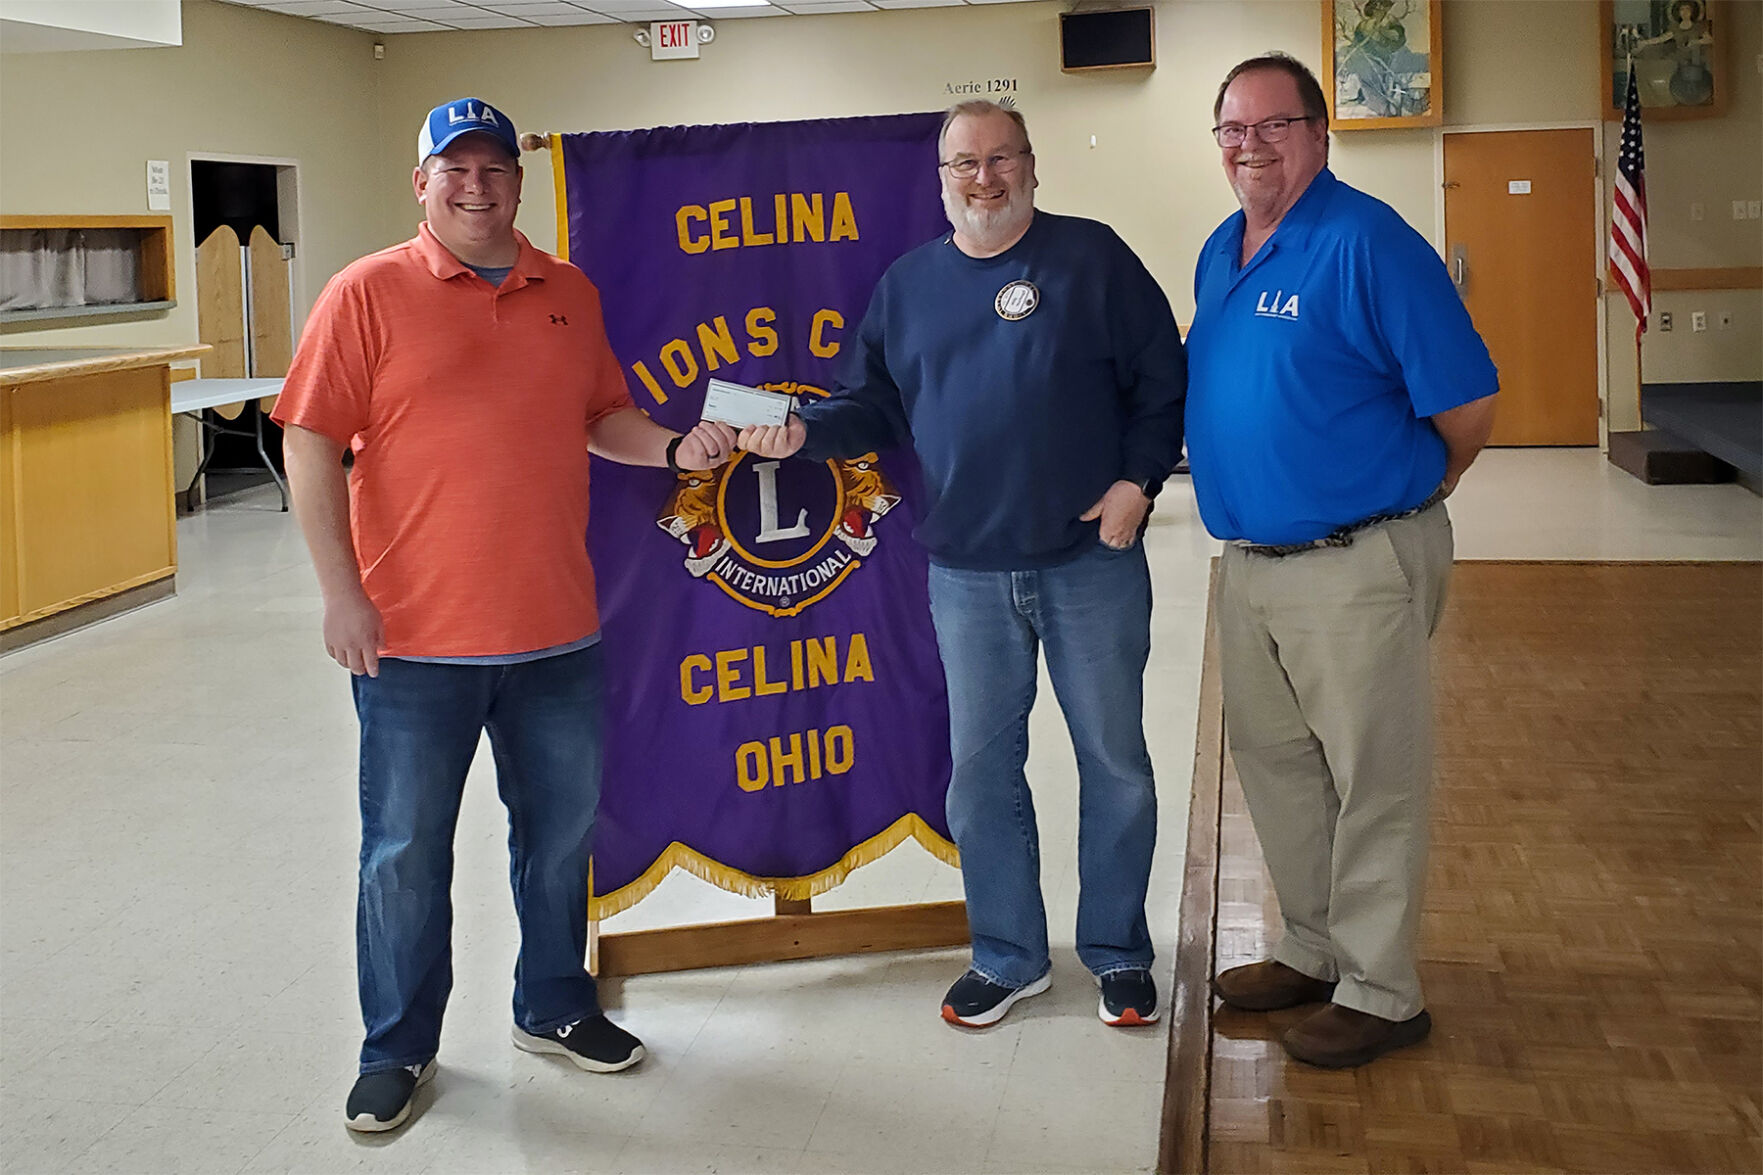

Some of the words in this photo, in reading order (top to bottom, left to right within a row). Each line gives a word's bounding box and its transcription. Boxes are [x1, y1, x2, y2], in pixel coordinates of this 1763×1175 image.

[660, 23, 690, 48] EXIT
[448, 102, 498, 125] LIA
[943, 81, 981, 94] Aerie
[987, 79, 1017, 93] 1291
[675, 192, 859, 254] CELINA
[1256, 290, 1299, 317] LIA
[632, 307, 778, 406] IONS
[752, 460, 811, 544] L
[715, 549, 852, 597] INTERNATIONAL
[680, 633, 875, 705] CELINA
[735, 725, 854, 792] OHIO
